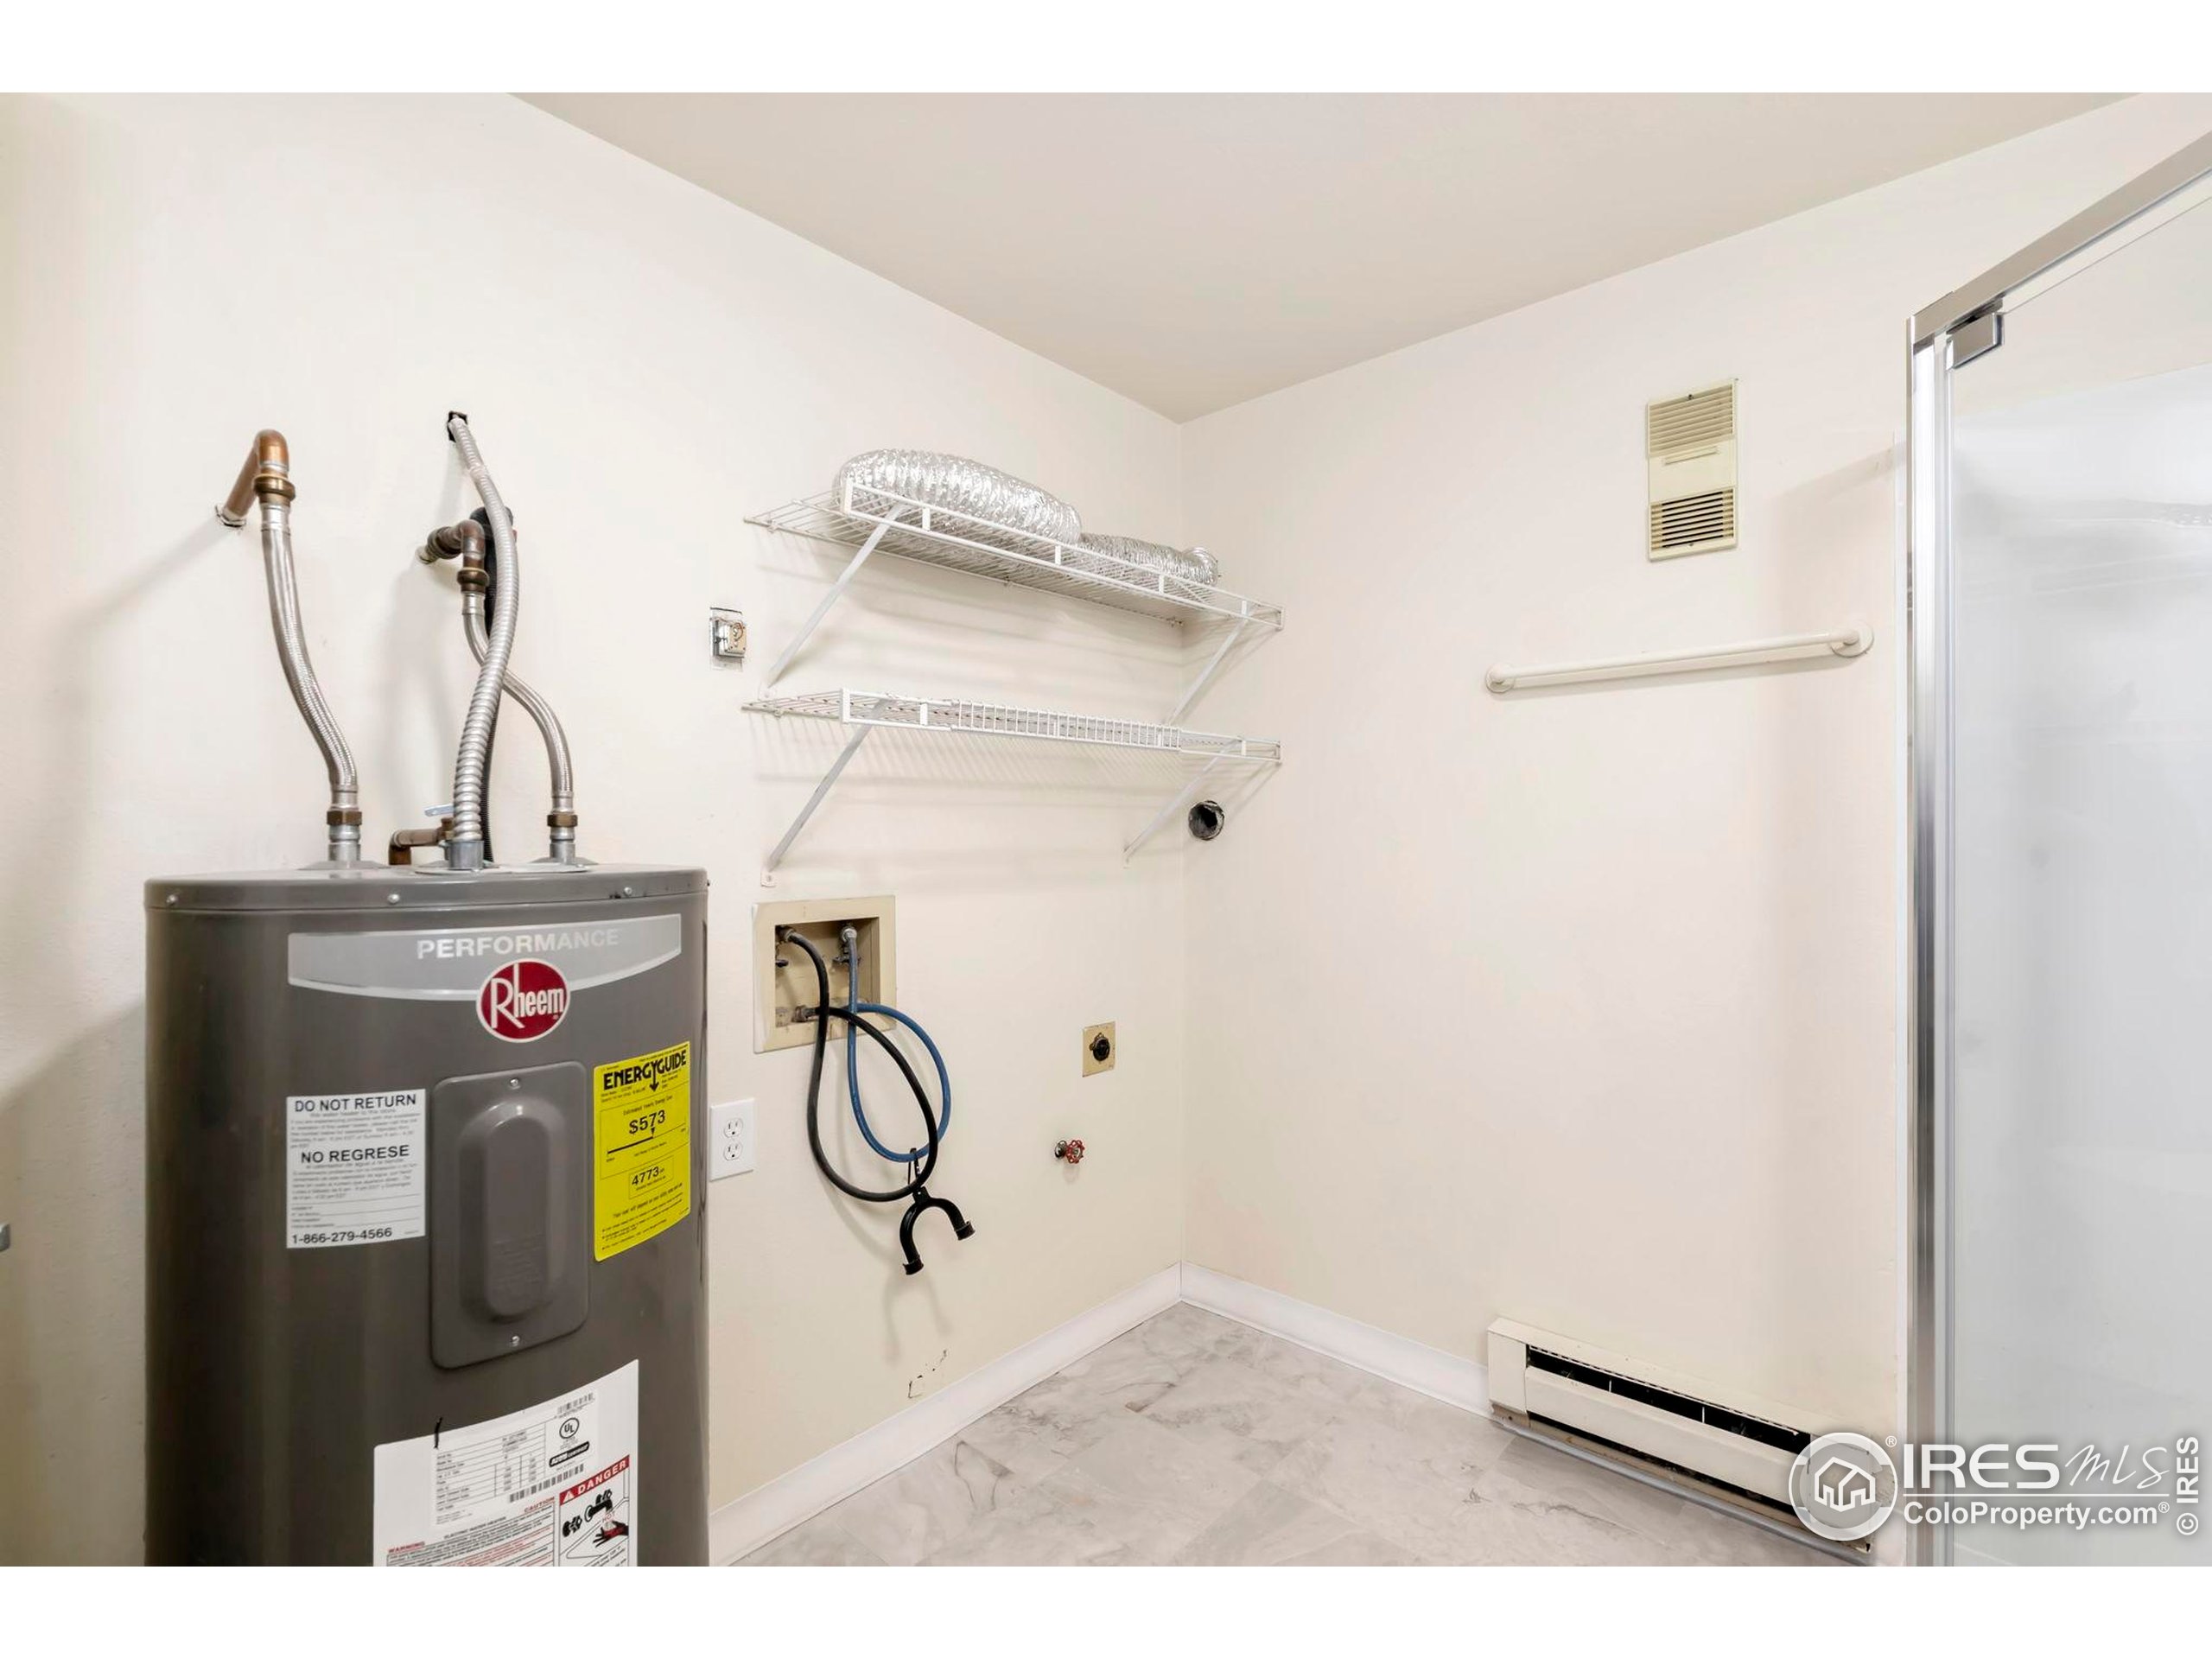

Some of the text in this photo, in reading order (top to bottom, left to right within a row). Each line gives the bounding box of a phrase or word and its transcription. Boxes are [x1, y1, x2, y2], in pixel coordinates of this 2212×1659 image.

[416, 928, 620, 959] PERFORMANCE
[490, 963, 564, 1029] Rheem
[603, 1049, 687, 1091] ENERGYGUIDE
[295, 1094, 416, 1112] DO NOT RETURN
[629, 1109, 665, 1135] $573
[301, 1145, 410, 1163] NO REGRESE
[632, 1166, 659, 1185] 4773
[292, 1227, 392, 1244] 1-866-279-4566
[577, 1459, 626, 1494] DANGER
